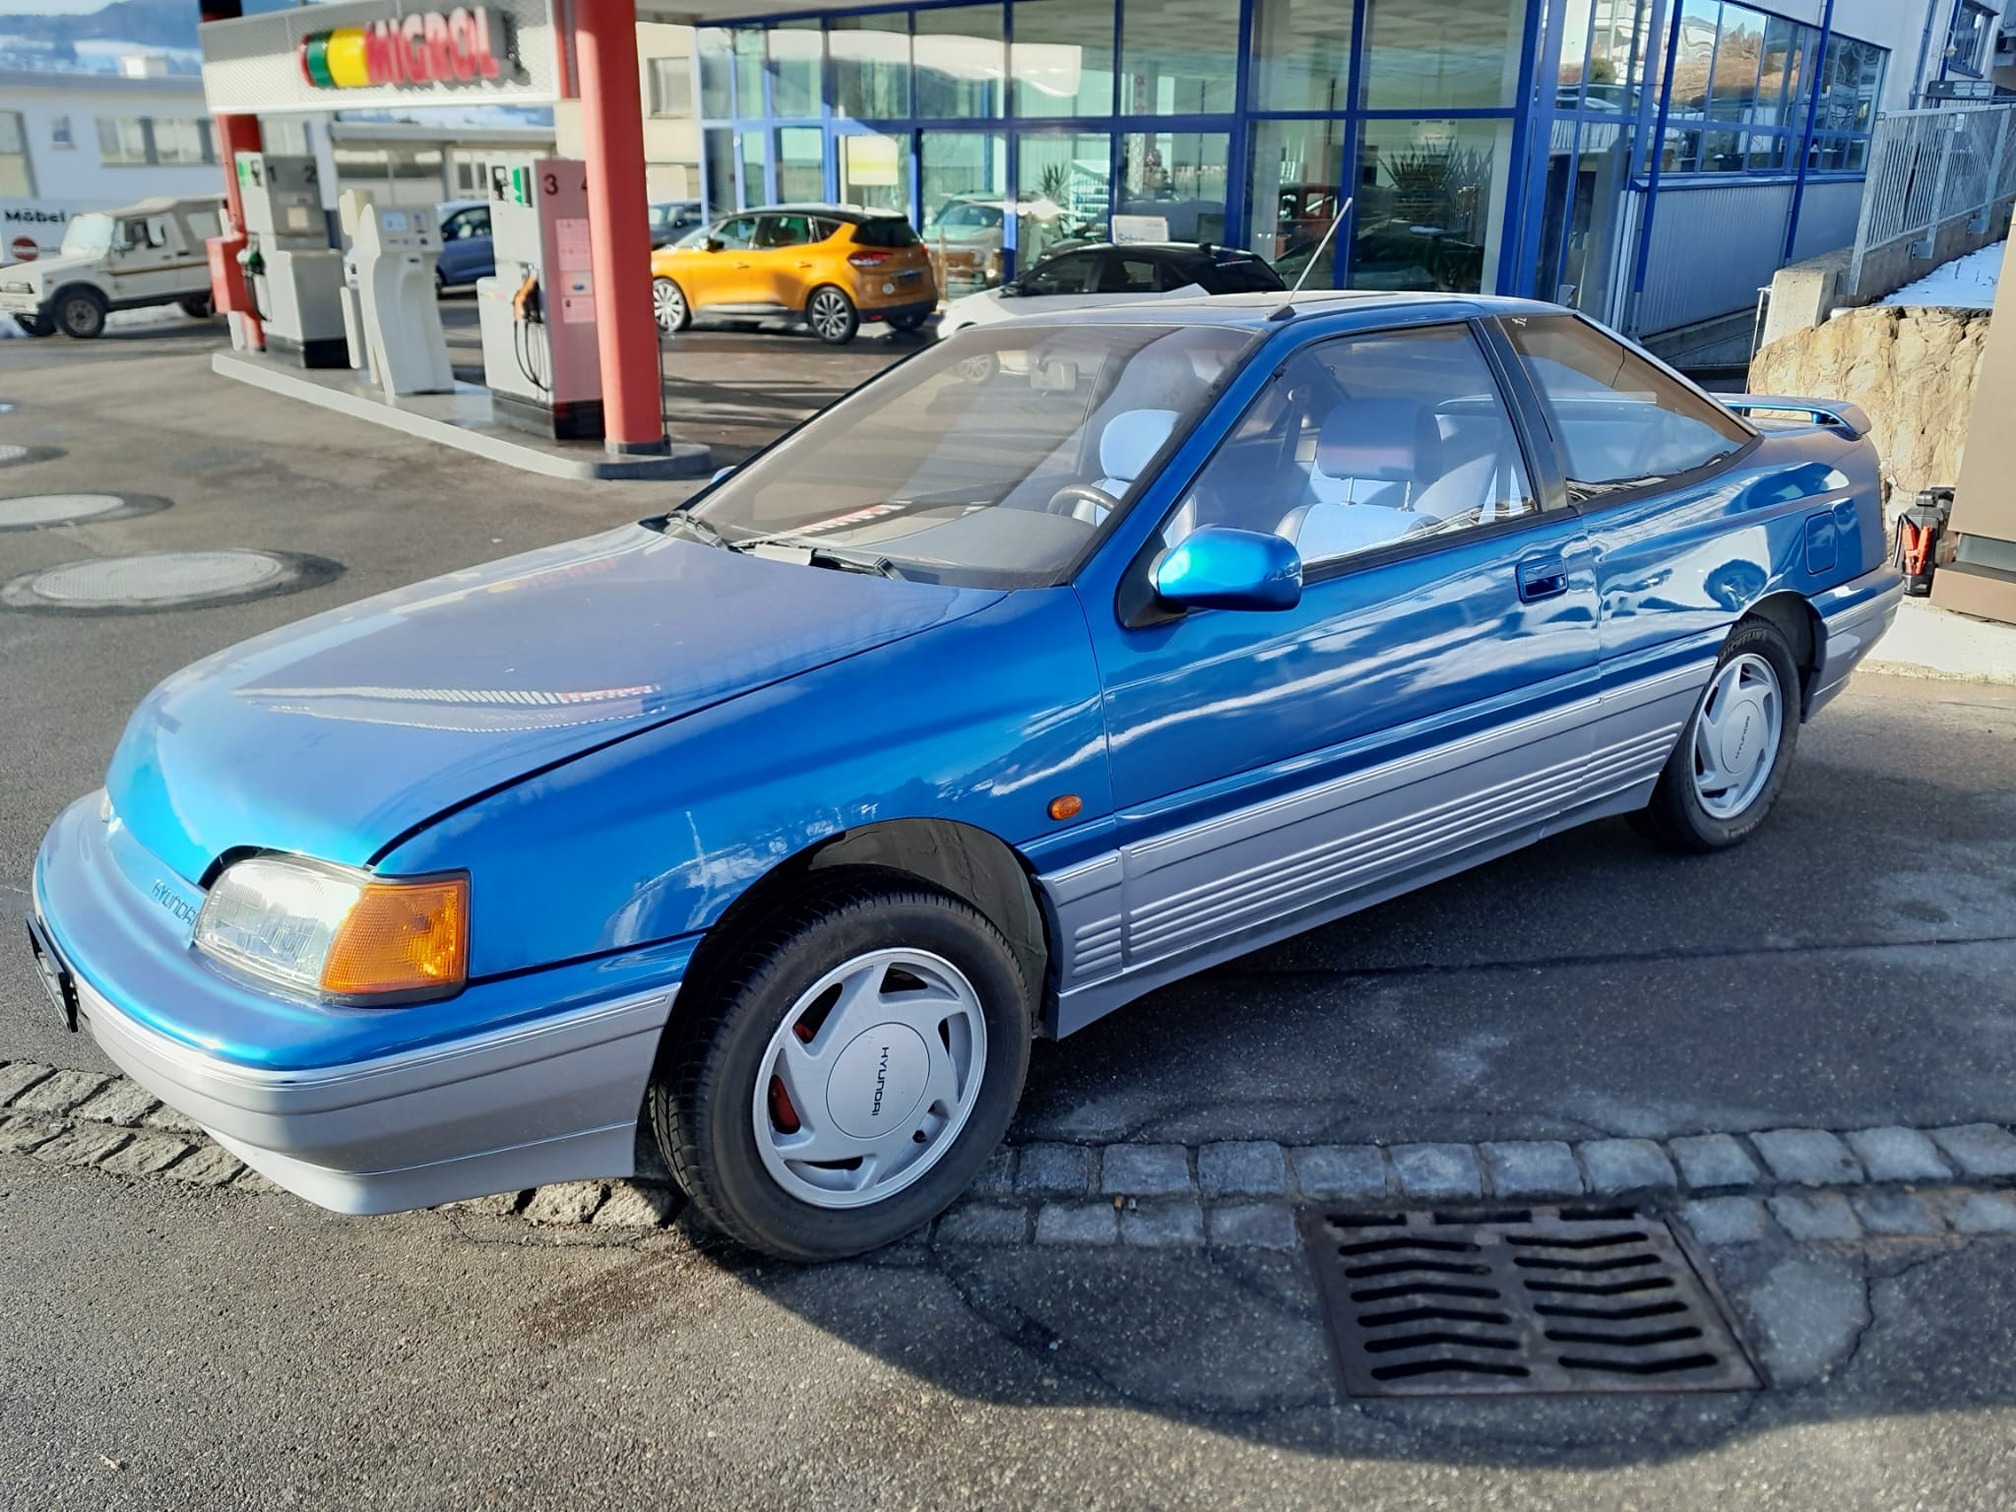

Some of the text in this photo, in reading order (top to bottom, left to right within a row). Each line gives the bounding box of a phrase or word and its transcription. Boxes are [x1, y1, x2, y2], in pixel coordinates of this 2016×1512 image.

[365, 6, 499, 86] MIGROL
[268, 165, 277, 182] 1
[304, 165, 317, 183] 2
[544, 174, 559, 196] 3
[5, 208, 66, 222] Möbel
[152, 881, 199, 927] HYUNDAI
[871, 1046, 890, 1117] HYUNDAI
